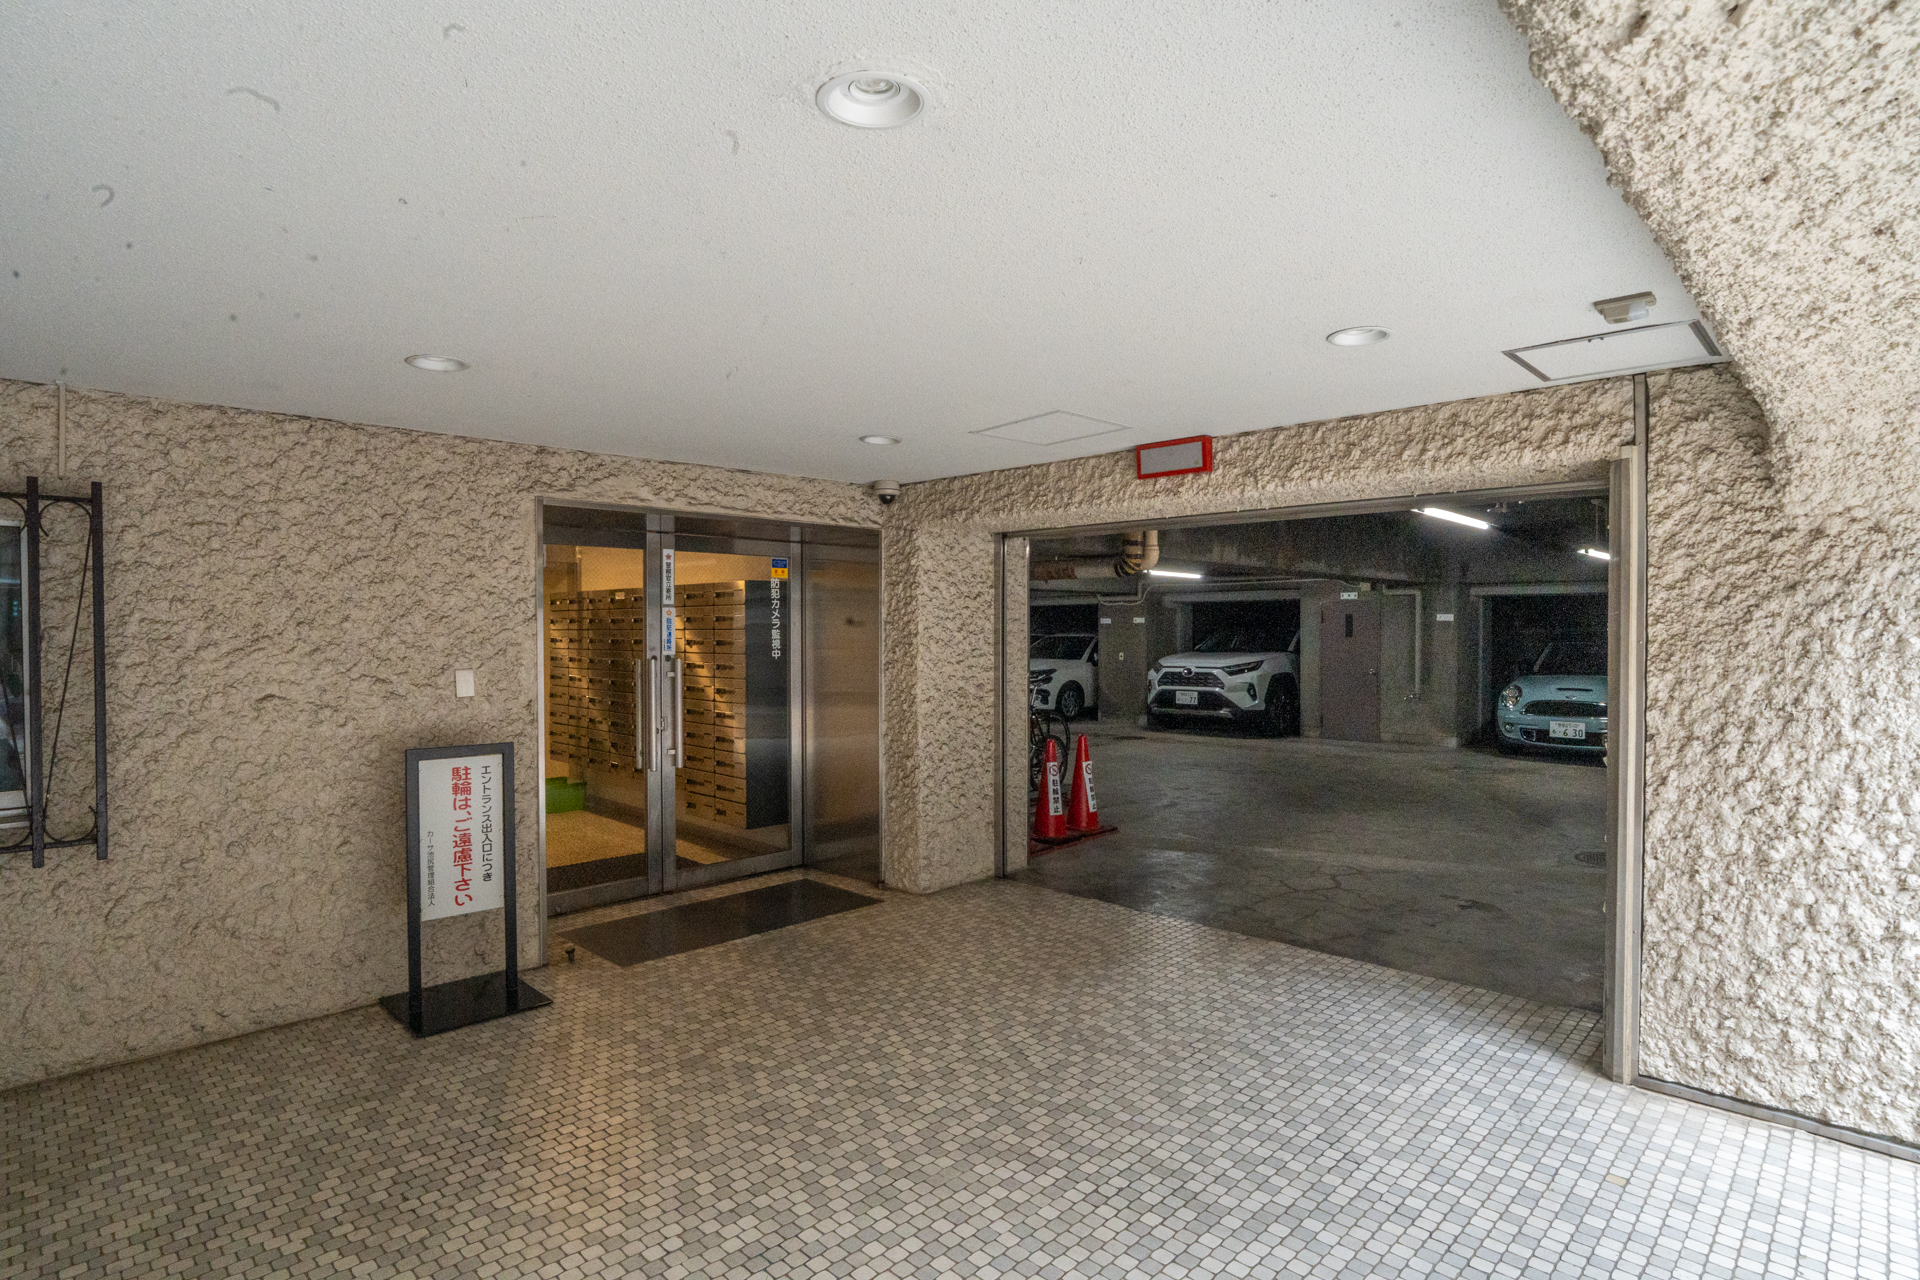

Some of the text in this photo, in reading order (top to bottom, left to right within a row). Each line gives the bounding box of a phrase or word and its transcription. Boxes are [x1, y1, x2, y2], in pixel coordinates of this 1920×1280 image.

[770, 578, 781, 660] 防犯カメラ監視中
[426, 830, 435, 907] カーサ池尻管理組合法人
[451, 766, 473, 906] 駐輪は、ご遠慮下さい
[481, 765, 493, 882] エントランス出入口につき
